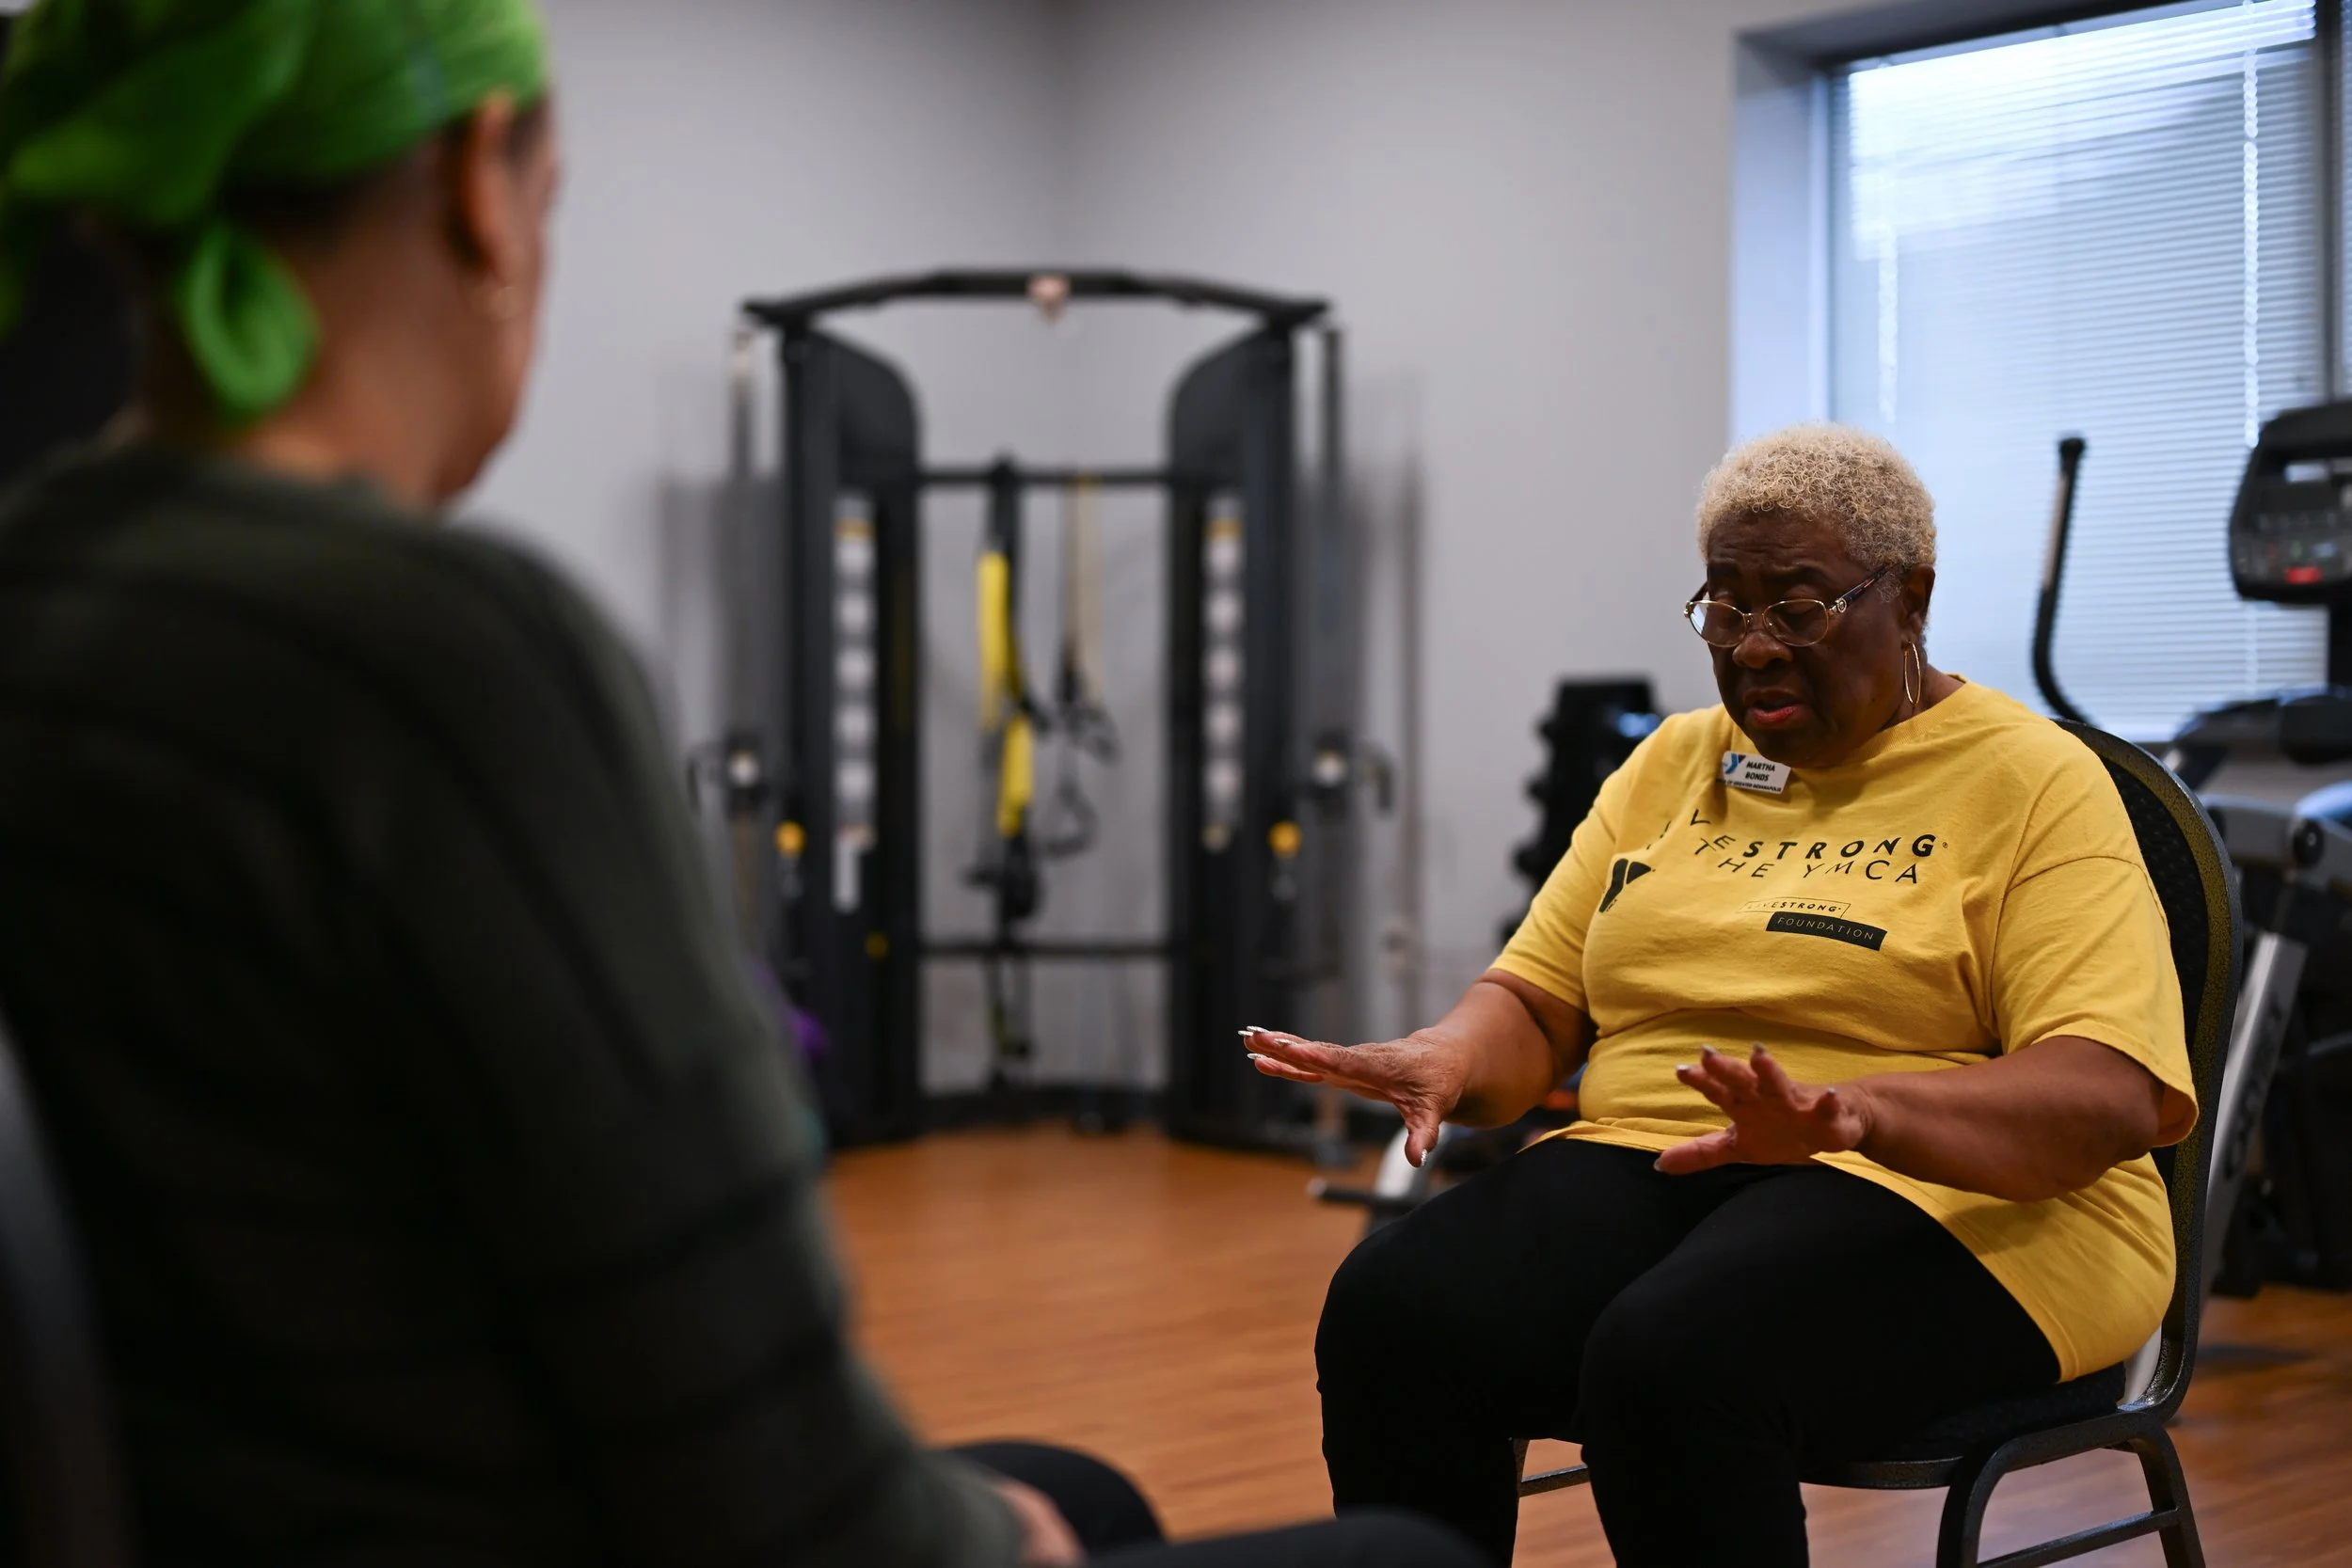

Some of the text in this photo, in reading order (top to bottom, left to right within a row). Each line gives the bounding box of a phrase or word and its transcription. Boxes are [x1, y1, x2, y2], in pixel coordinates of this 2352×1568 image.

[1746, 761, 1775, 771] MARTHA
[1745, 771, 1770, 782] BONDS
[1661, 808, 1936, 860] VESTRONG
[1694, 837, 1917, 884] THE YMCA
[1747, 901, 1837, 912] VESTRONG
[1777, 916, 1874, 941] FOUNDATION
